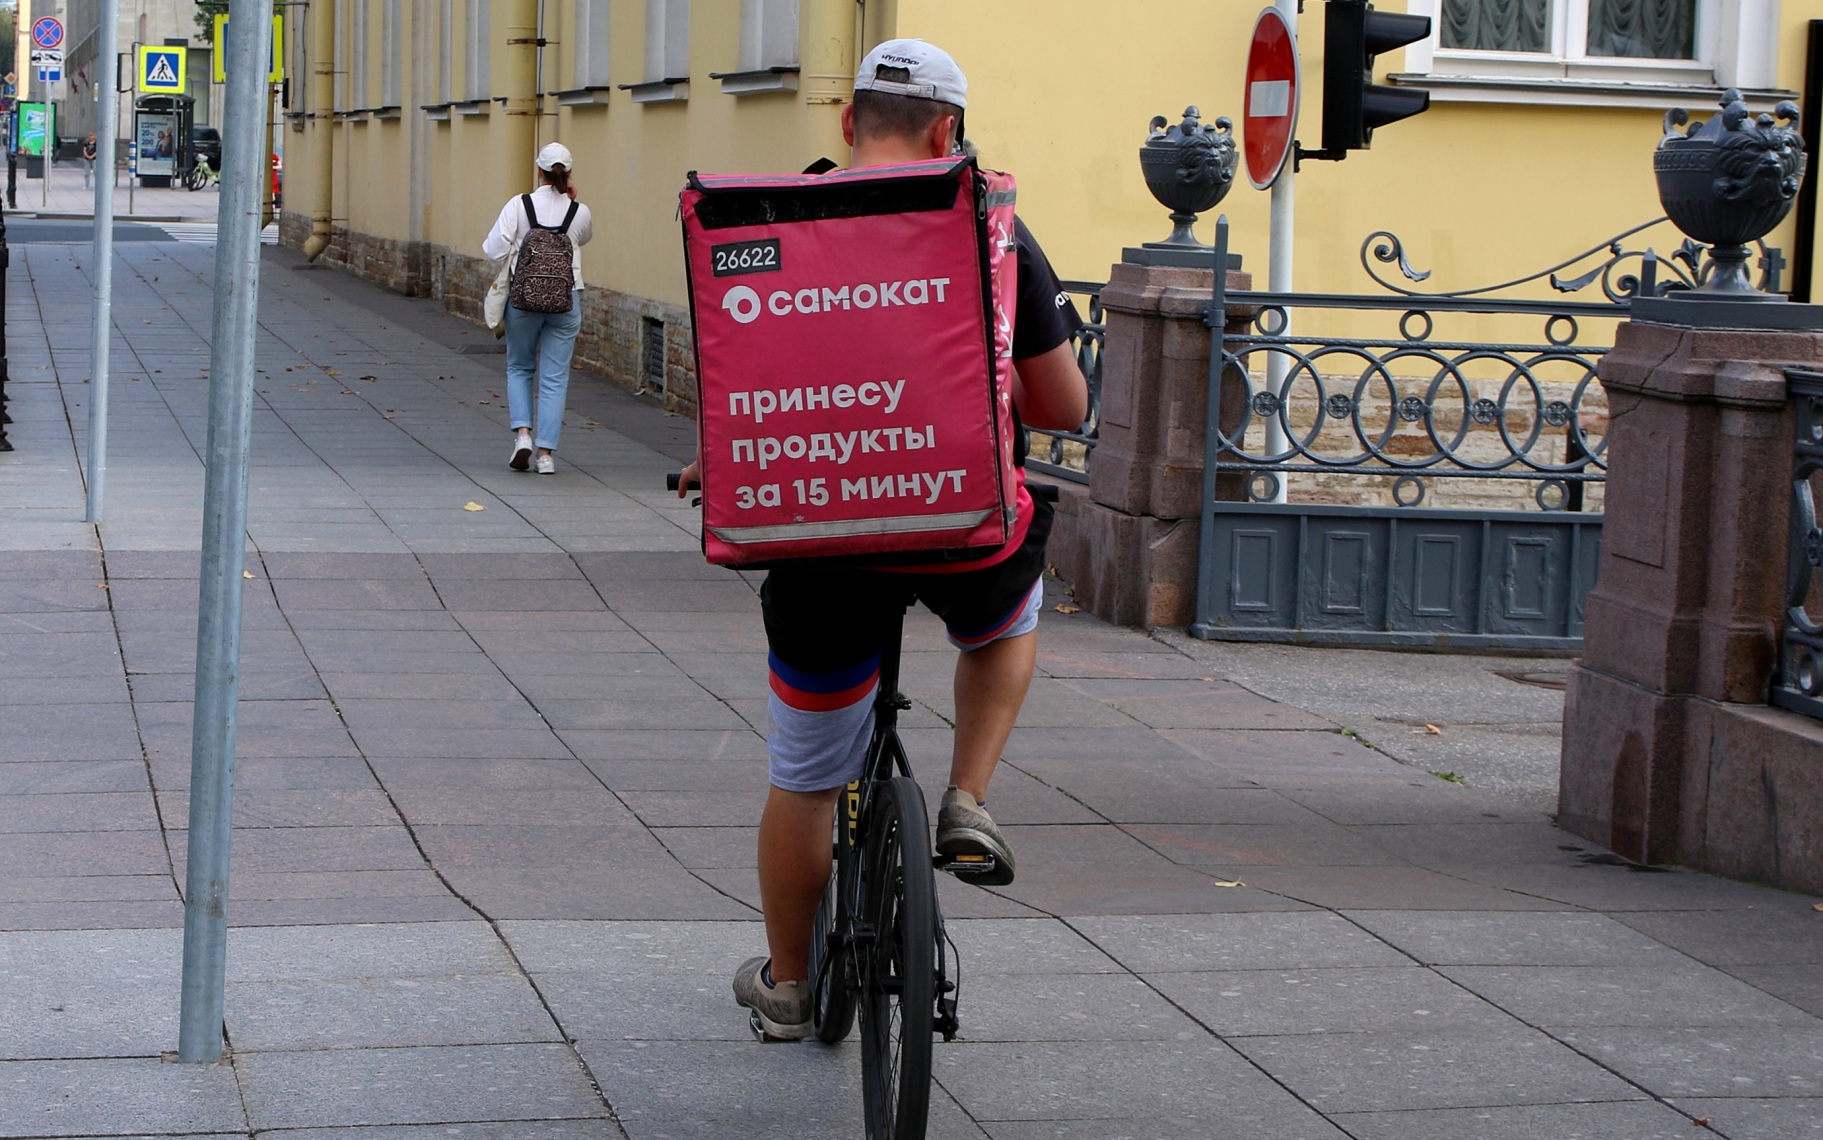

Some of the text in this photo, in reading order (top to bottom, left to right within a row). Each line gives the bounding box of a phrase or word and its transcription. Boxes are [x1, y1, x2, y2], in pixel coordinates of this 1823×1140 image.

[881, 54, 920, 66] HYUNDAI
[716, 246, 776, 271] 26622
[767, 277, 951, 316] самокат
[729, 379, 906, 424] принесу
[731, 424, 936, 470] продукты
[735, 469, 967, 509] за 15 минут
